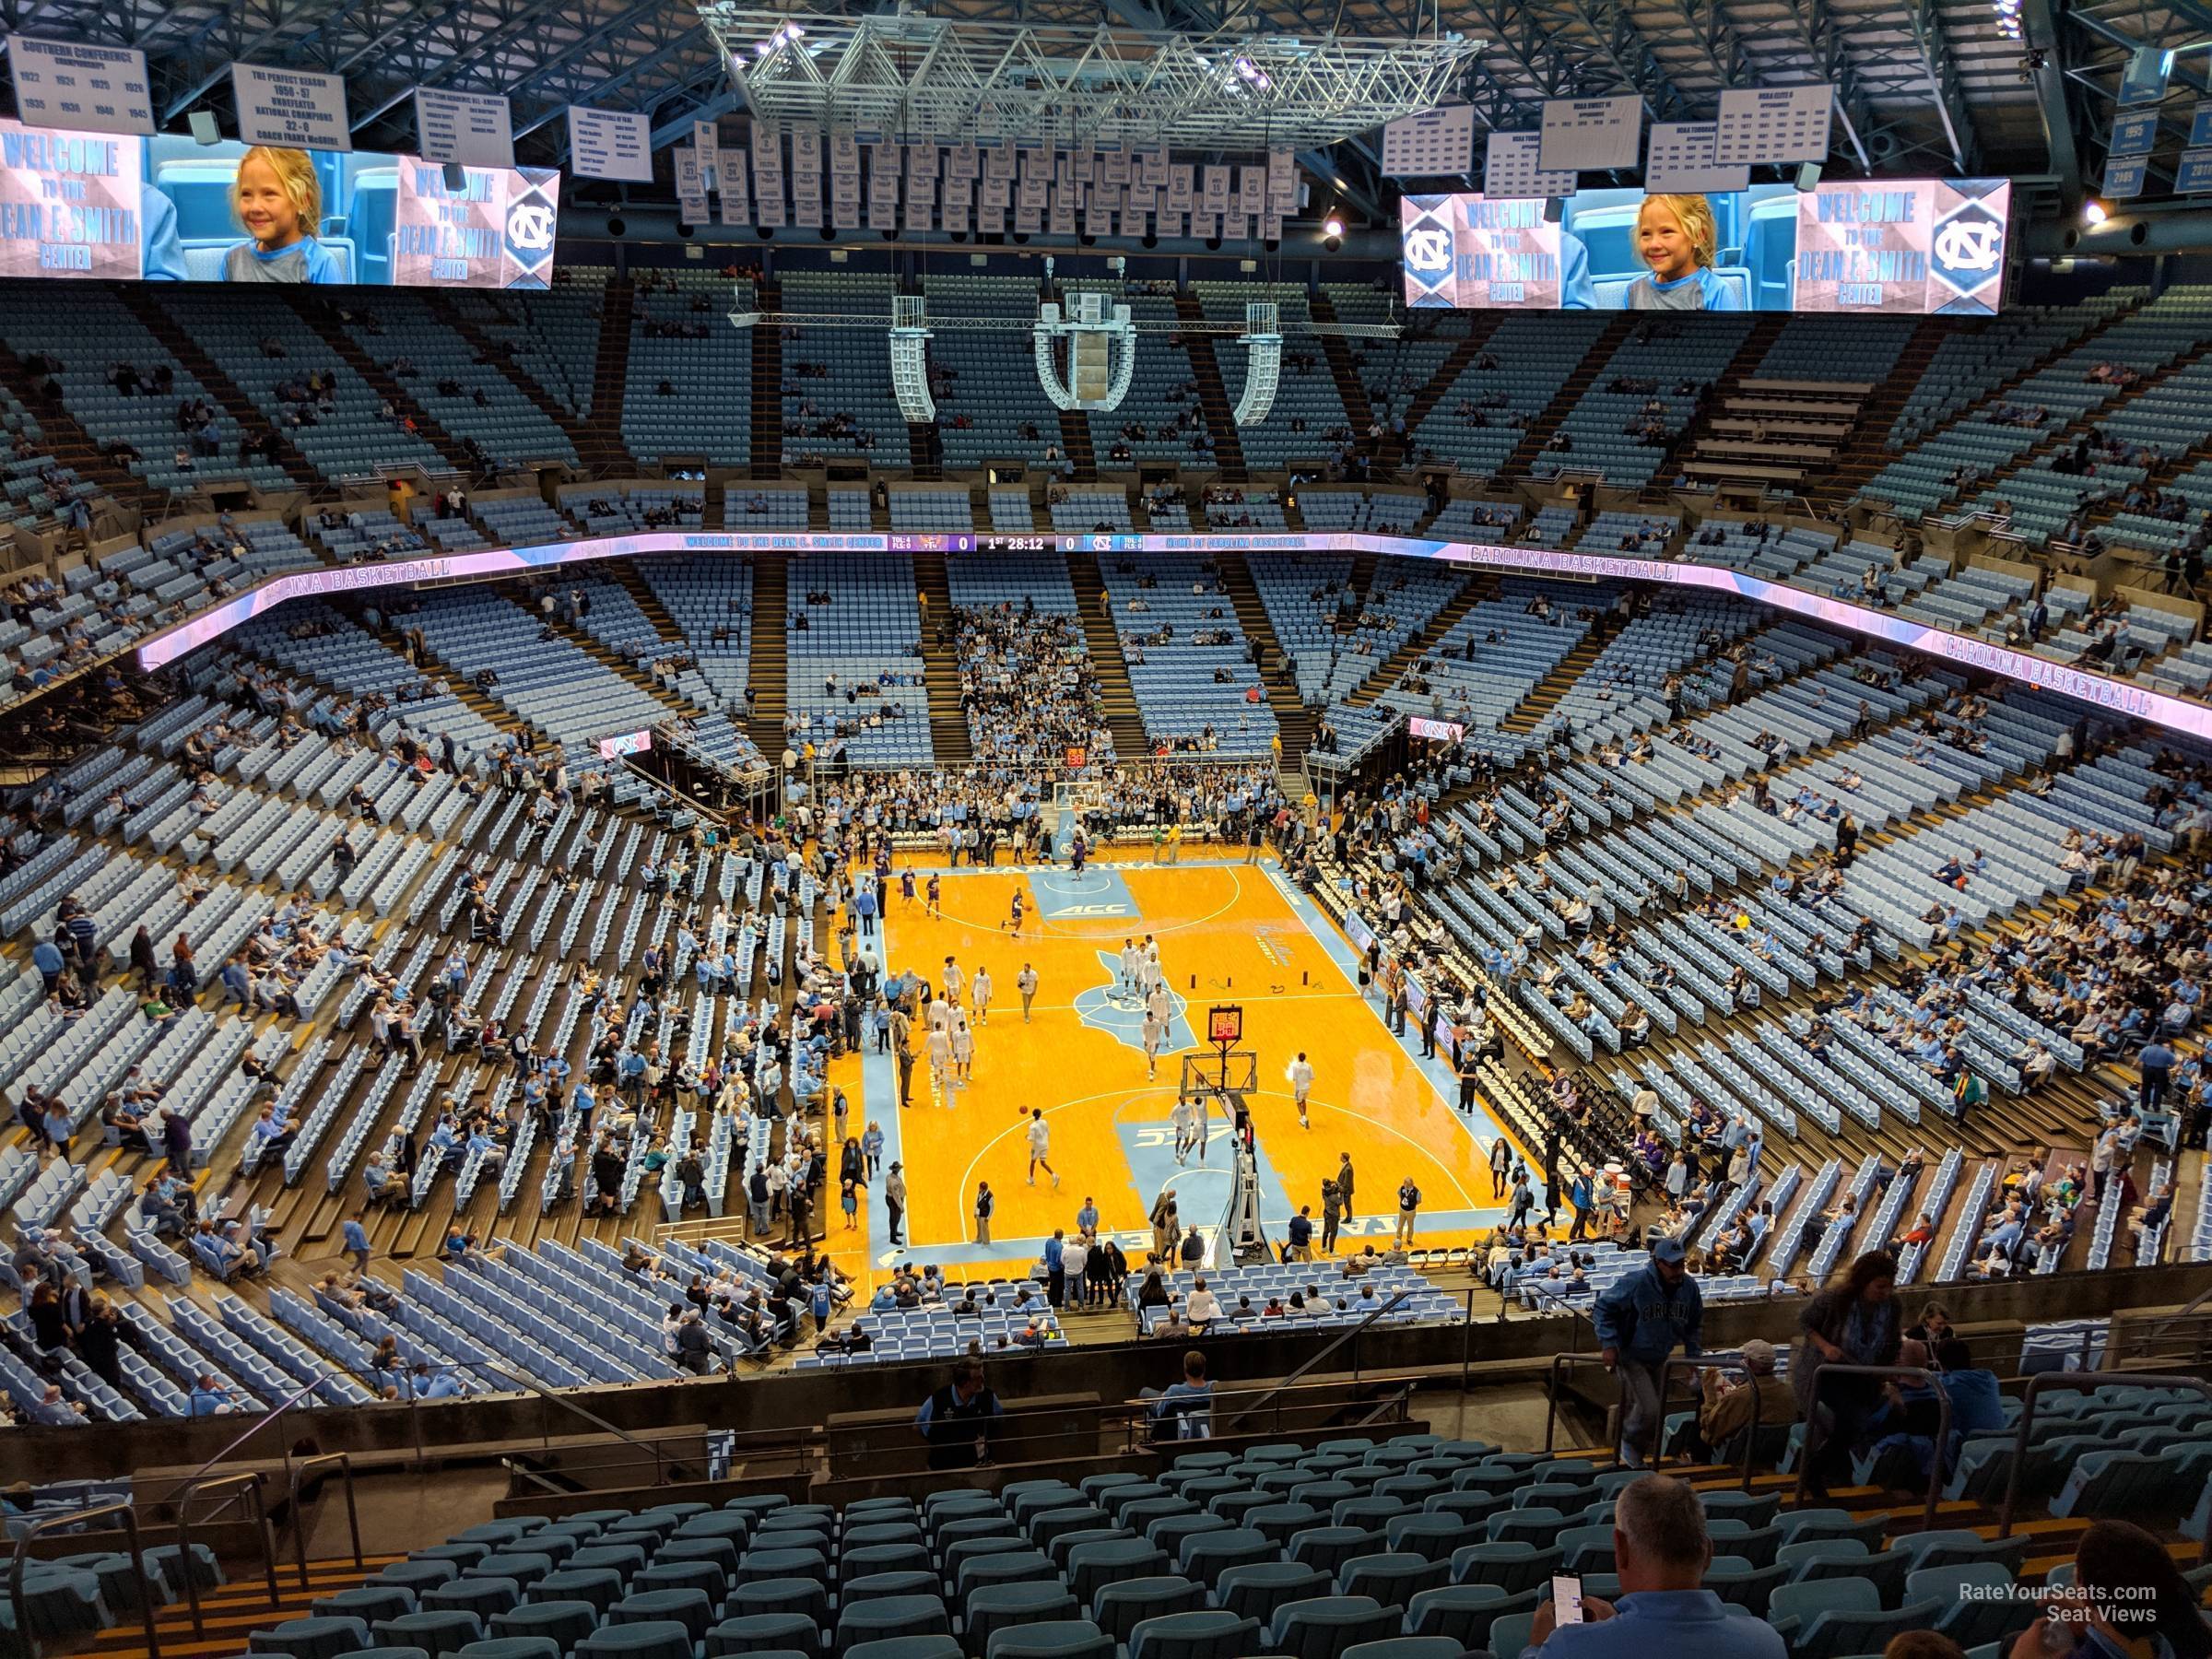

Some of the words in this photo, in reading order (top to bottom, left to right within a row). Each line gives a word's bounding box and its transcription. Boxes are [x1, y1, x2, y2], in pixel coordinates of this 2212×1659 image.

[22, 40, 73, 57] SOUTHERN
[74, 47, 133, 64] CONFERENCE
[252, 70, 266, 81] THE
[267, 73, 298, 85] PERFECT
[300, 76, 327, 88] SEASON
[271, 97, 316, 110] UNDEFEATED
[300, 88, 311, 99] 57
[128, 108, 148, 119] 1945
[255, 106, 291, 118] NATIONAL
[291, 110, 334, 123] CHAMPIONS
[285, 120, 297, 132] 32
[256, 130, 283, 141] COACH
[284, 133, 306, 143] FRANK
[1, 132, 119, 177] WELCOME
[41, 179, 57, 198] TO
[61, 178, 88, 200] THE
[416, 168, 494, 203] WELOME
[439, 205, 449, 222] TO
[452, 206, 469, 222] THE
[1466, 201, 1544, 229] WELCOME
[1817, 191, 1916, 222] WELCOME
[0, 202, 43, 240] EAN
[52, 205, 65, 241] E
[70, 206, 135, 244] SMITH
[399, 224, 437, 256] DEAN
[442, 227, 451, 256] E
[456, 227, 501, 259] SMITH
[1490, 234, 1501, 250] TO
[1503, 233, 1521, 249] THE
[1845, 229, 1858, 245] TO
[1861, 228, 1883, 246] THE
[40, 243, 92, 270] CENTER
[1799, 250, 1844, 280] DEAN
[1851, 251, 1861, 281] E
[1866, 250, 1926, 281] SMITH
[431, 258, 468, 280] CENTER
[1457, 253, 1492, 281] DEAN
[1497, 253, 1505, 281] E
[1509, 253, 1557, 281] SMITH
[1488, 282, 1524, 302] CENTER
[1838, 283, 1883, 305] CENTER
[687, 536, 733, 547] WELCOME
[738, 537, 749, 547] TO
[752, 537, 769, 547] THE
[773, 537, 796, 547] DEAN
[812, 537, 843, 547] SMITH
[847, 538, 883, 547] CENTER
[959, 537, 968, 550] 0
[988, 537, 1004, 550] 1ST
[1007, 537, 1043, 550] 28:12
[1065, 537, 1074, 550] 0
[1166, 537, 1191, 547] HOME
[1194, 538, 1204, 547] OF
[1207, 538, 1250, 547] CAROLINA
[1253, 536, 1305, 547] BASKETBALL
[1471, 547, 1552, 569] CAROLINA
[1559, 554, 1673, 581] BASKETBALL
[331, 559, 451, 590] BASKETBALL
[1946, 636, 2023, 677] CAROLINA
[2030, 662, 2148, 716] BASKETBALL
[1046, 904, 1128, 917] ACC
